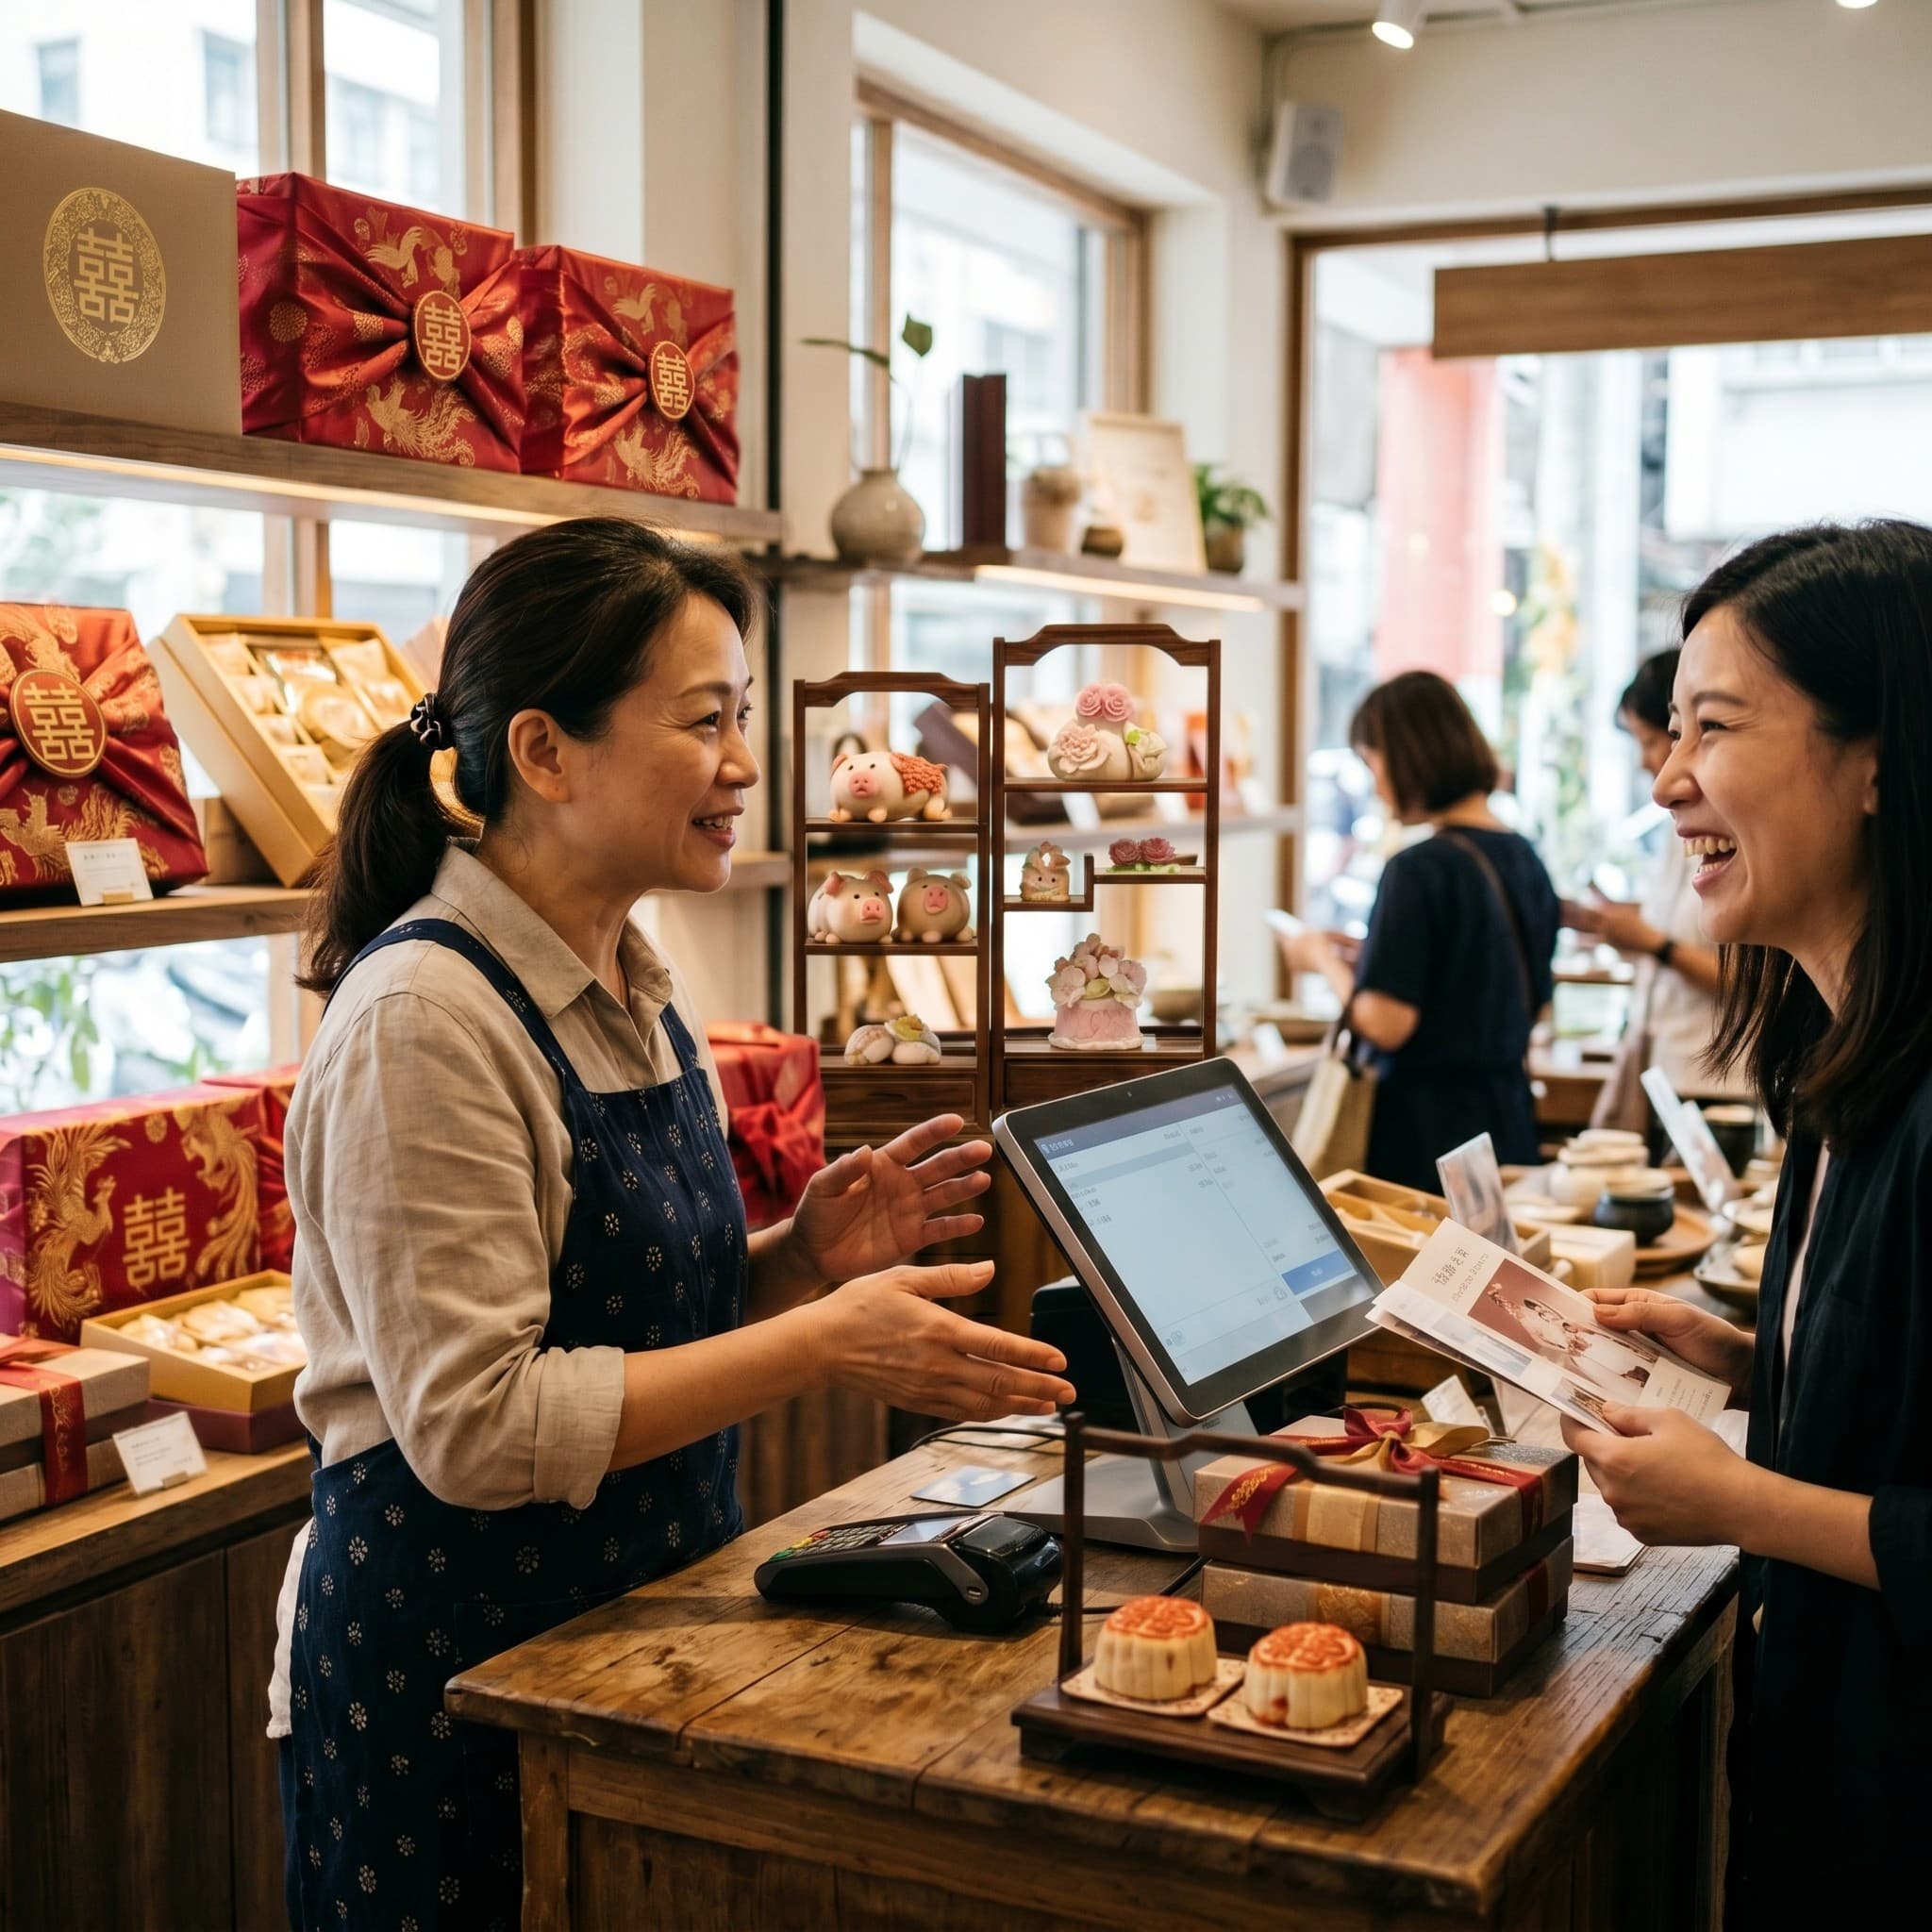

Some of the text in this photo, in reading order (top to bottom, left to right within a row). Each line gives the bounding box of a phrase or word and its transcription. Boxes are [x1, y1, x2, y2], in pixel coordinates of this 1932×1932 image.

[74, 226, 140, 324] 囍
[421, 302, 464, 370] 囍
[656, 351, 689, 410] 囍
[22, 682, 94, 760] 囍
[123, 1187, 190, 1288] 囍
